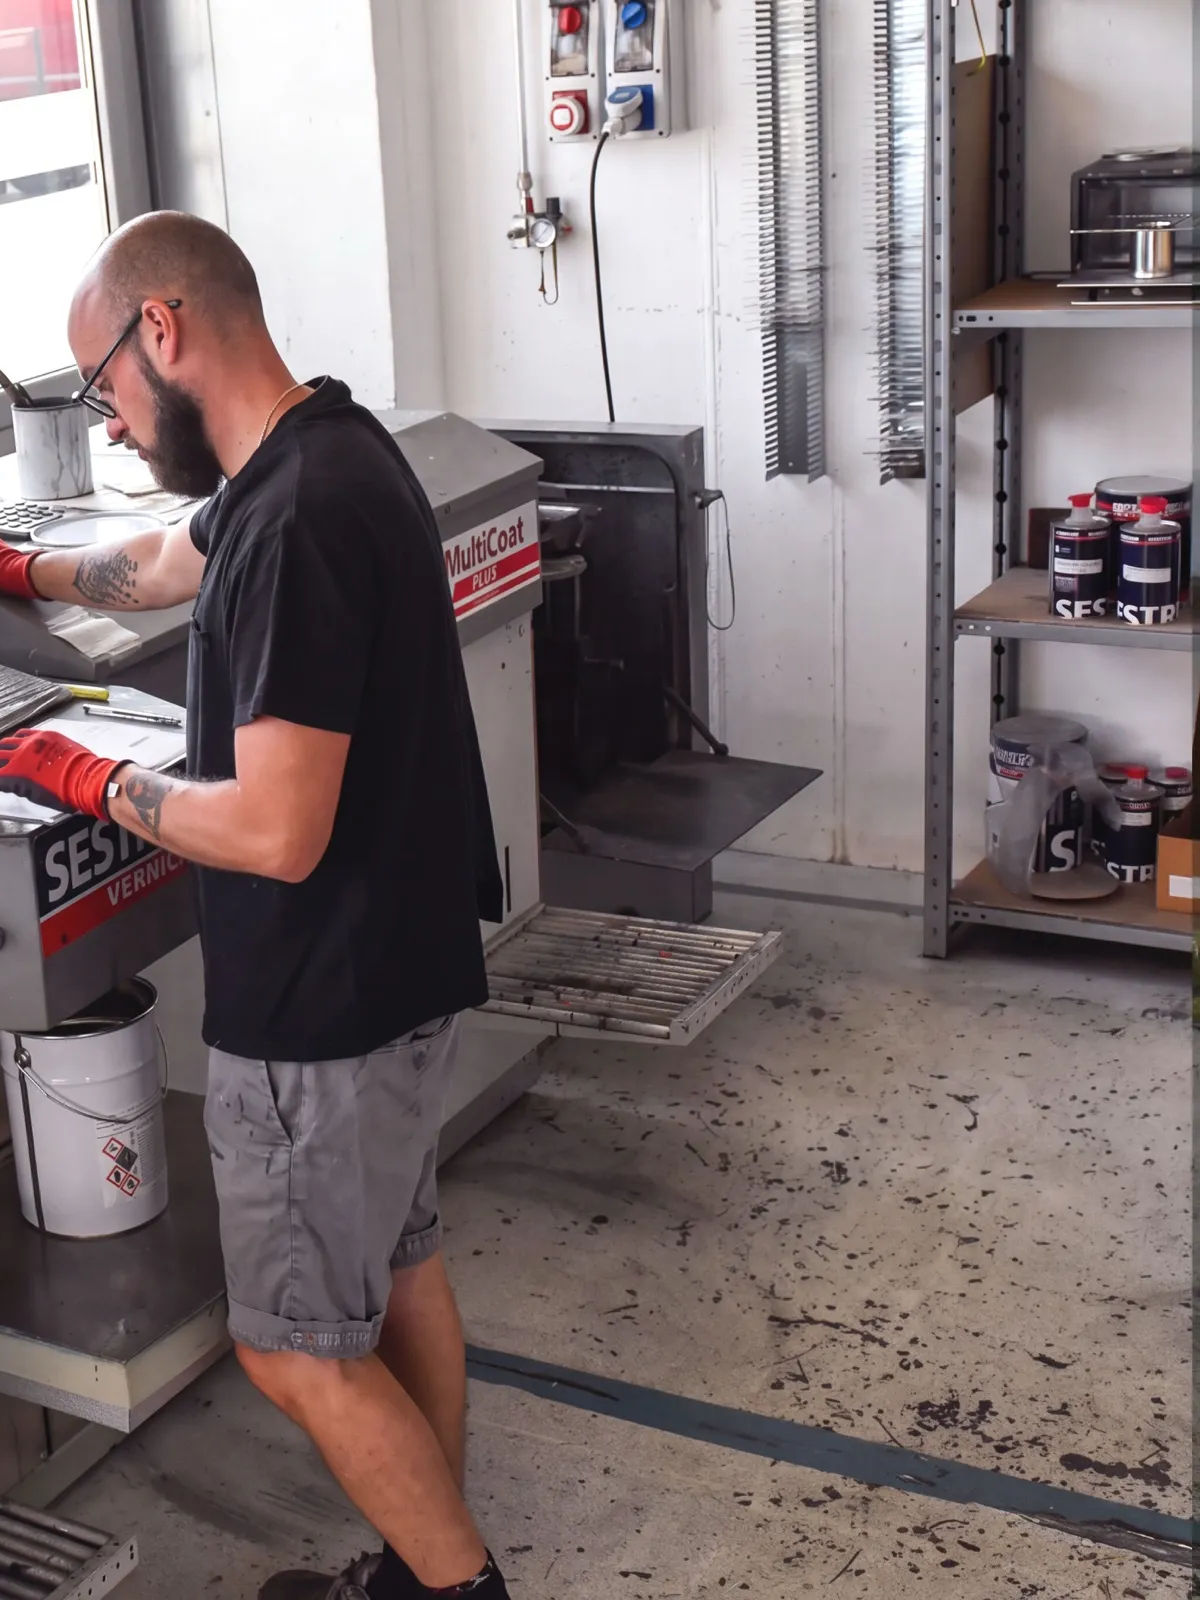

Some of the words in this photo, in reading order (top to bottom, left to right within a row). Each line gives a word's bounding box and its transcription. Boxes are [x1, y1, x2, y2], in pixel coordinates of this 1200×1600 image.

[445, 516, 525, 577] MultiCoat
[472, 565, 498, 591] PLUS
[45, 819, 144, 903] SES
[107, 852, 184, 906] VERNIC
